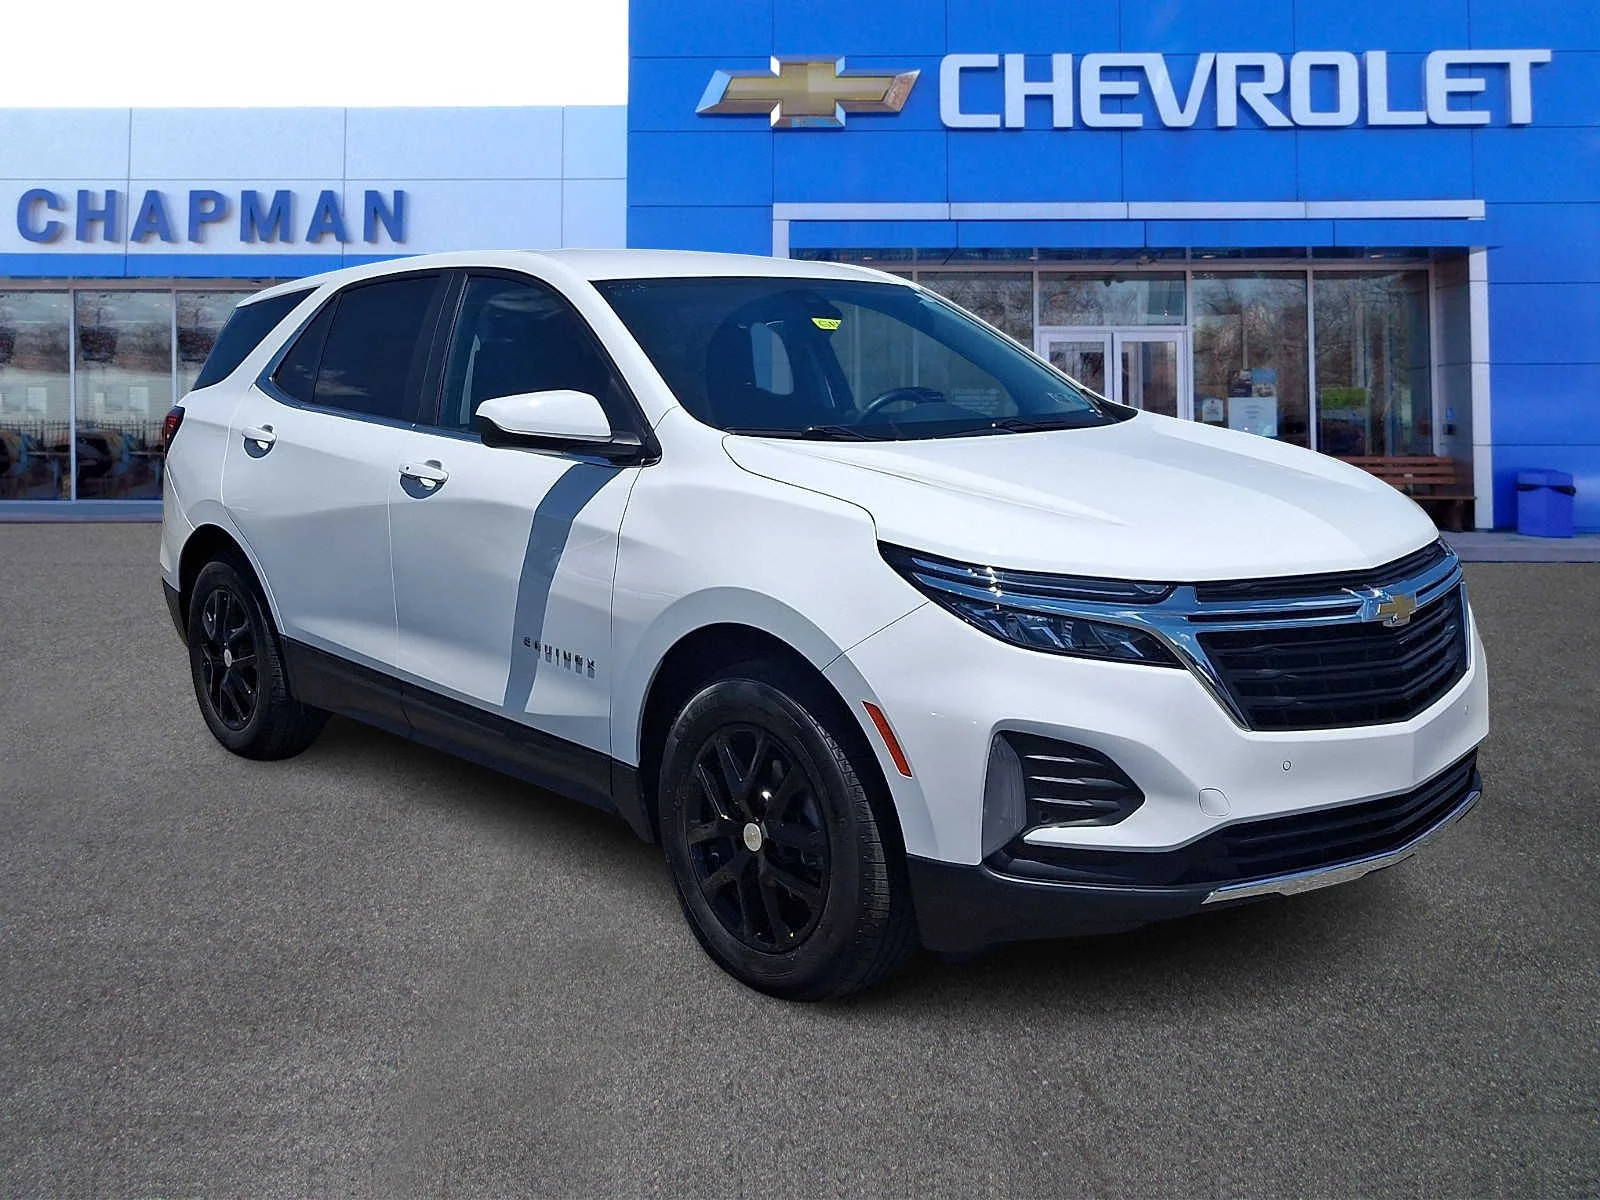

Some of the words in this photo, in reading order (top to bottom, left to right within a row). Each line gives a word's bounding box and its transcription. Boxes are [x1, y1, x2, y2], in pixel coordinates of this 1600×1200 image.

[939, 48, 1552, 129] CHEVROLET
[16, 188, 408, 243] CHAPMAN
[522, 636, 597, 671] EQUINOX
